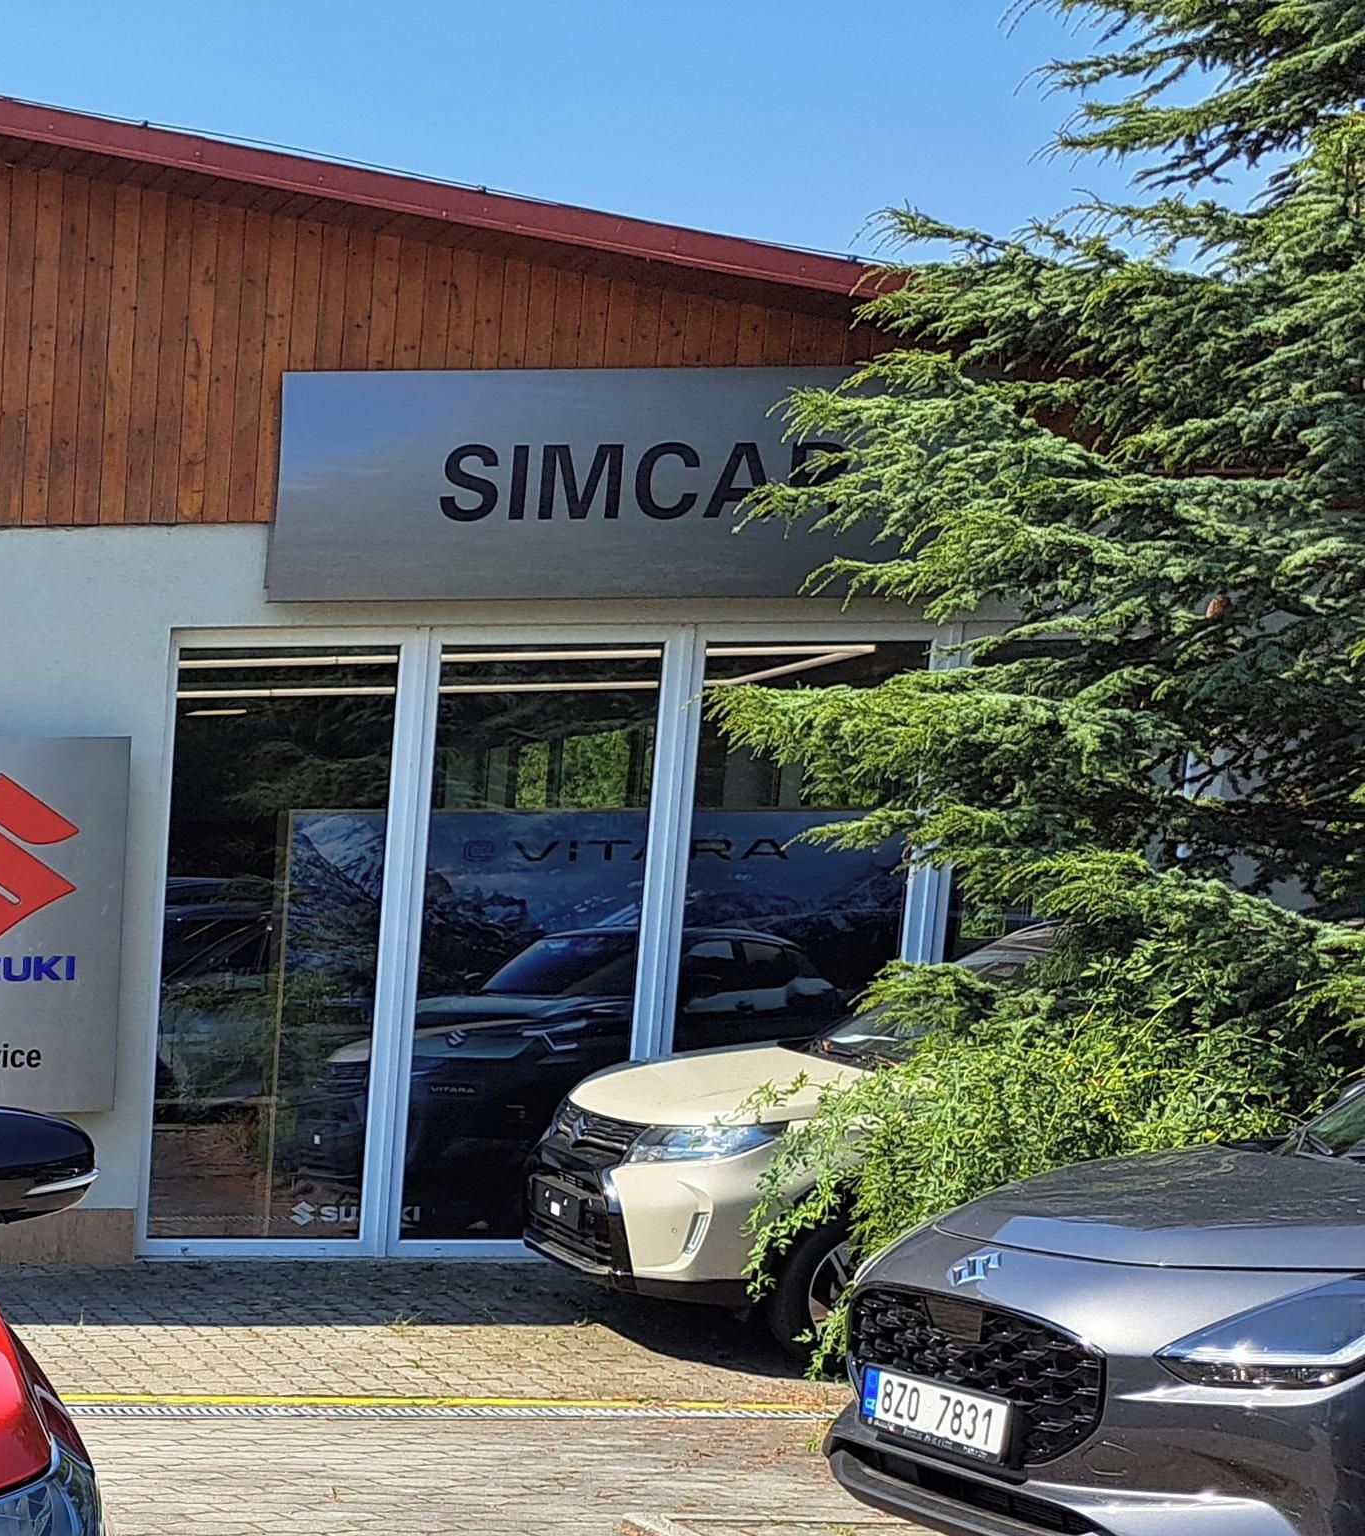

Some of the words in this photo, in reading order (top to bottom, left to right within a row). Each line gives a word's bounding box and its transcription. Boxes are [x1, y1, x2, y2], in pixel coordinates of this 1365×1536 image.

[515, 838, 790, 862] VITRA
[864, 1398, 876, 1410] CZ
[934, 1394, 994, 1446] 7831
